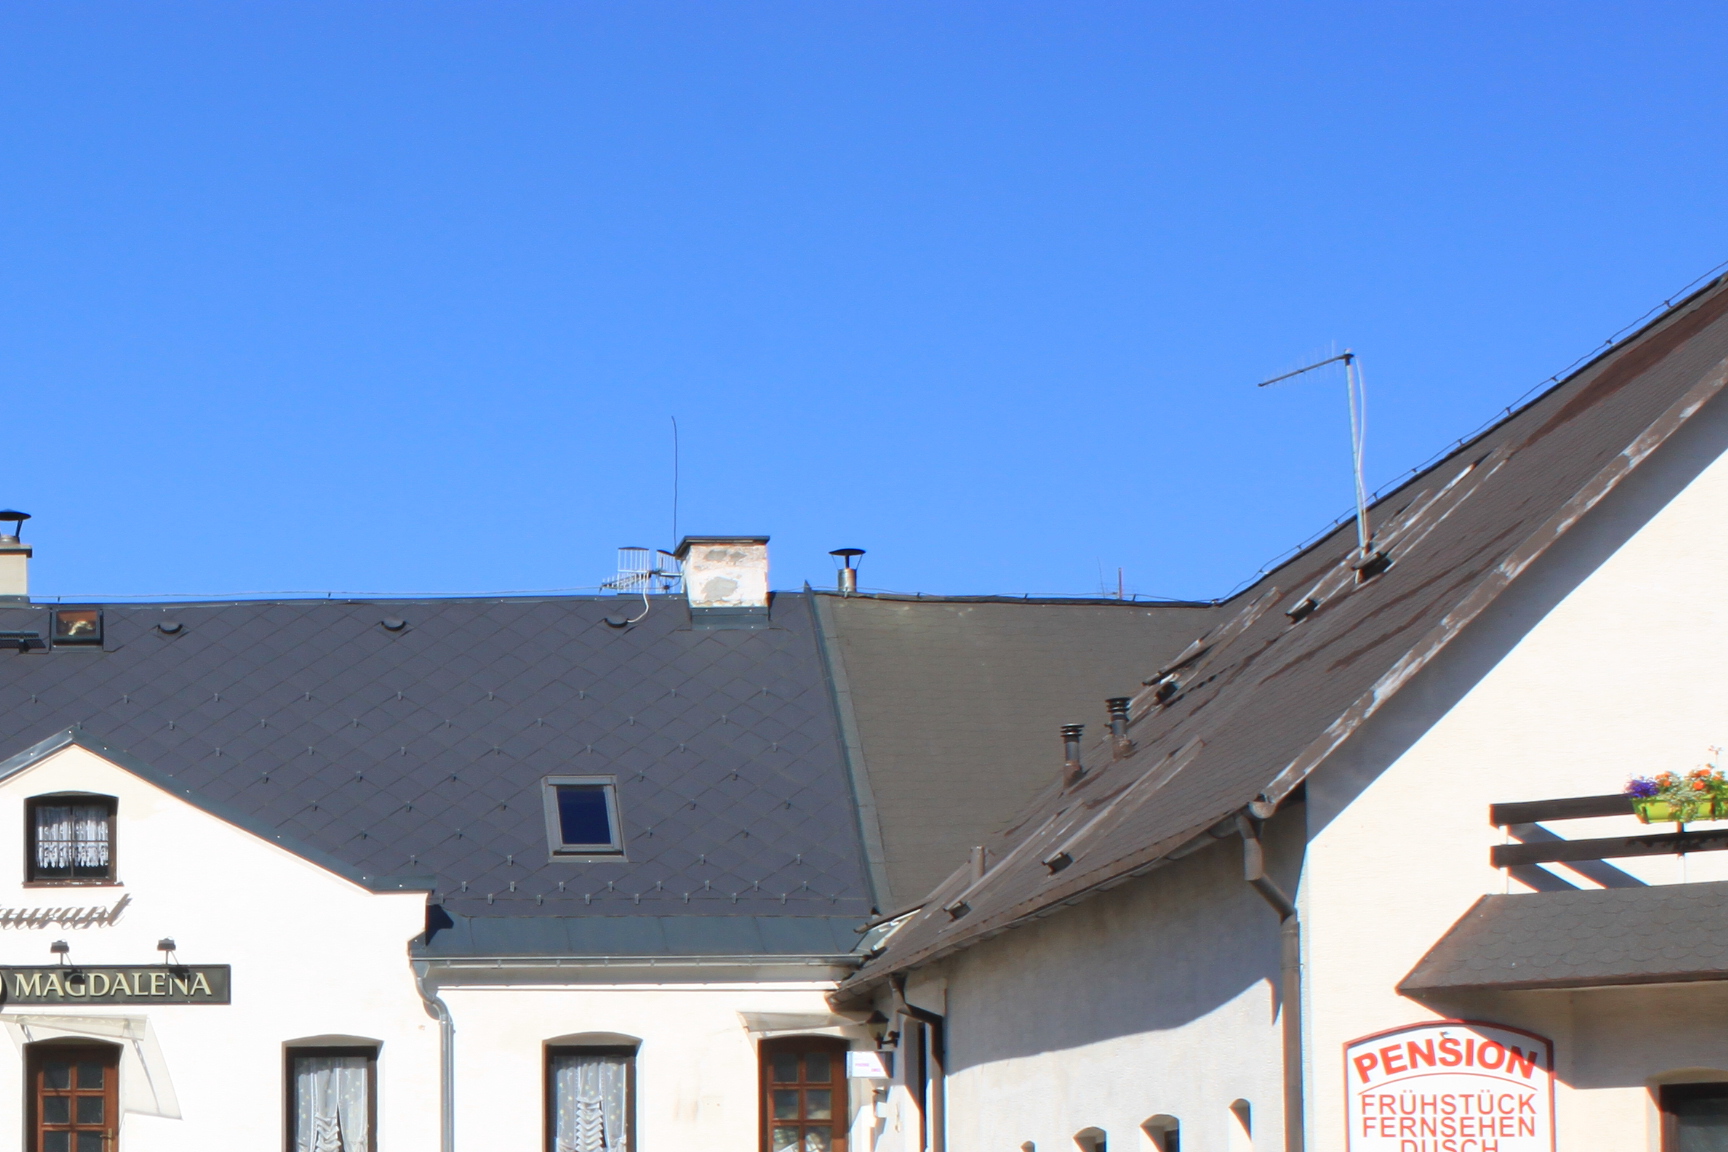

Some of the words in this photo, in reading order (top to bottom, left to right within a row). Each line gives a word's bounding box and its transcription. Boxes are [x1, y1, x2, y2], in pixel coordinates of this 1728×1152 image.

[14, 972, 212, 997] MAGDALENA
[1353, 1038, 1538, 1084] PENSION
[1361, 1089, 1537, 1115] FRÜHSTÜCK
[1362, 1116, 1535, 1138] FERNSEHEN
